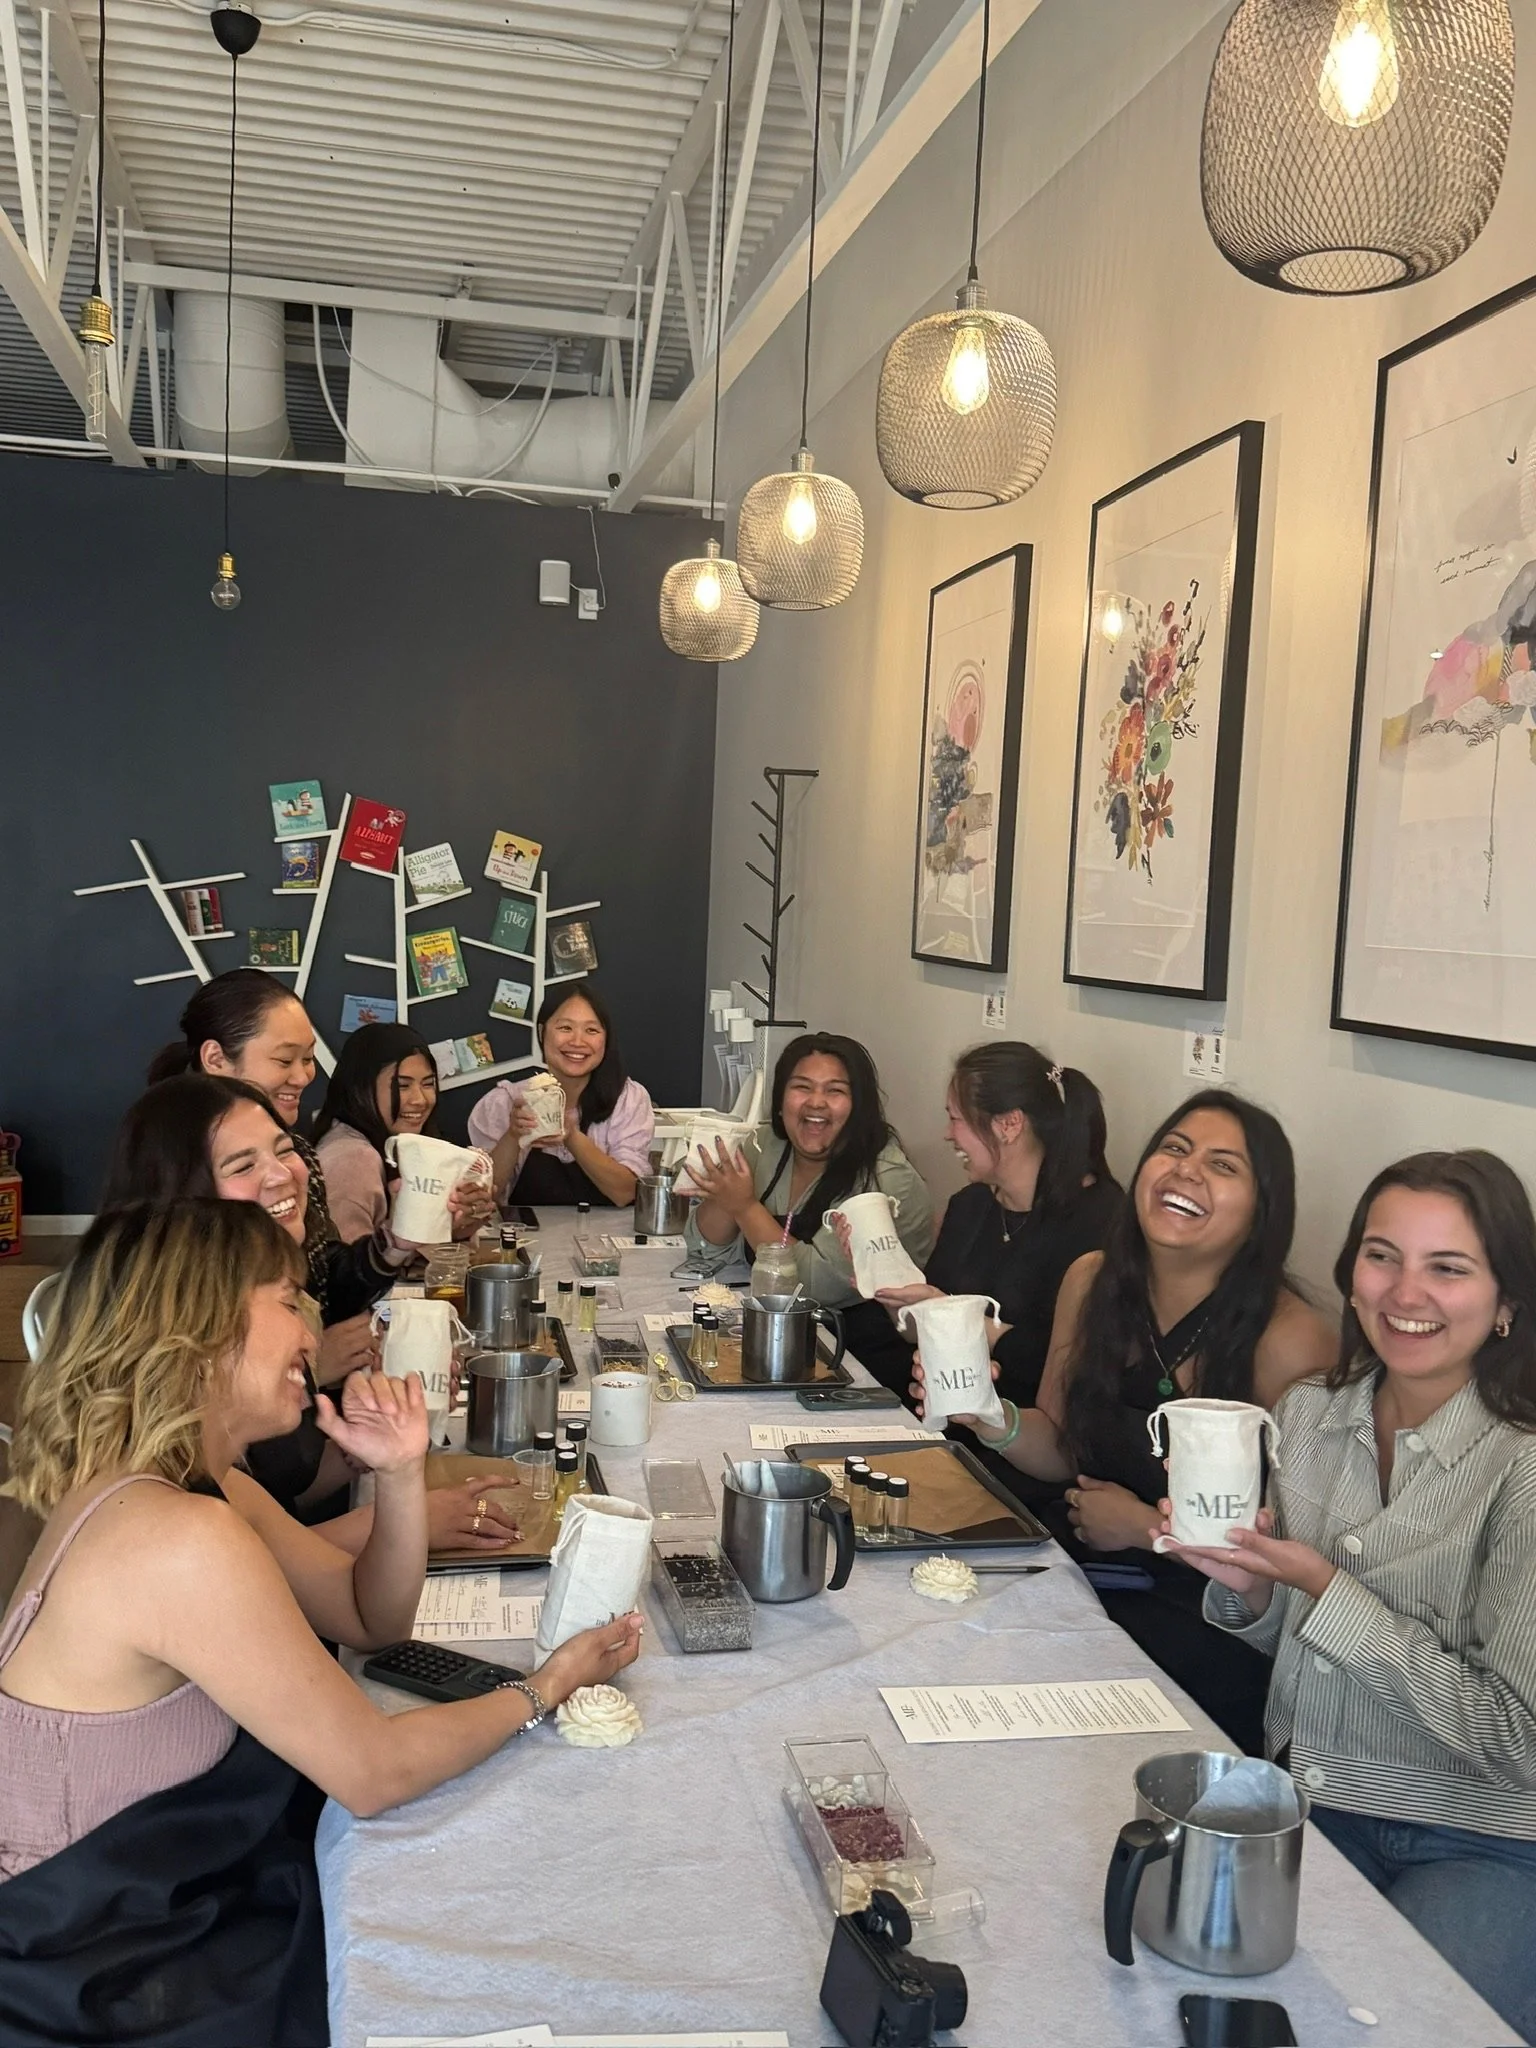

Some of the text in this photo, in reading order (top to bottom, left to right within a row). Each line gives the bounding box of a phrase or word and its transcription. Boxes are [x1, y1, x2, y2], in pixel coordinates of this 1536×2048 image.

[407, 848, 450, 868] Alligator
[409, 866, 427, 878] Pie
[940, 1366, 974, 1391] ME
[1195, 1492, 1242, 1519] ME
